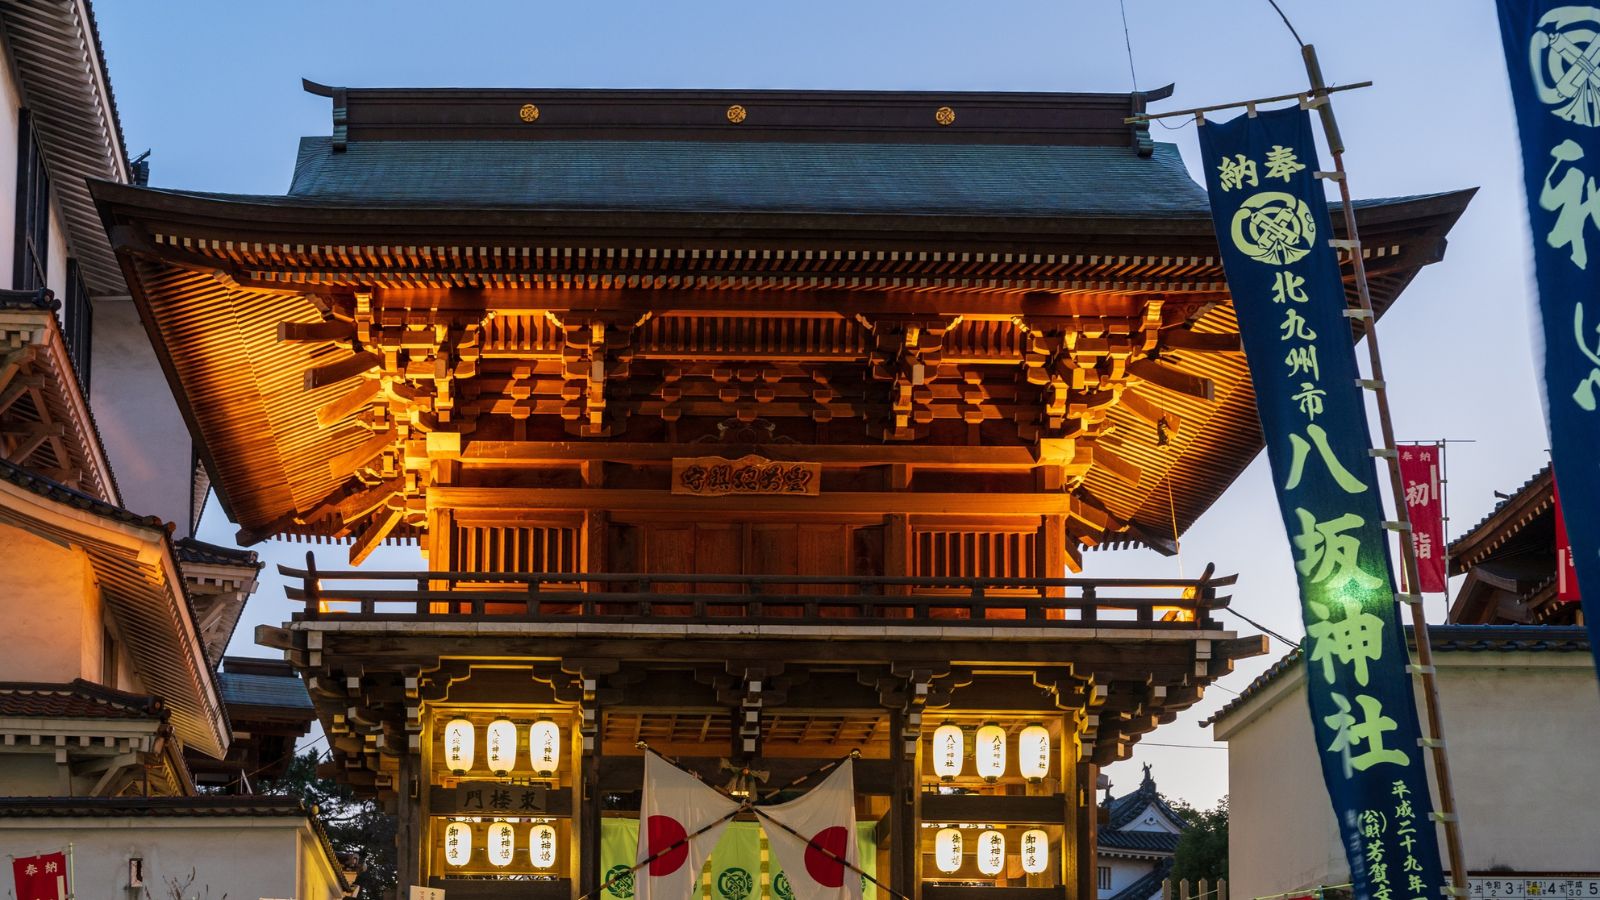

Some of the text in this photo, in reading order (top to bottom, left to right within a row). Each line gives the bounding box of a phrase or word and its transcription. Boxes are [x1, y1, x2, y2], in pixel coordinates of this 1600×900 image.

[1391, 779, 1428, 900] 平成二十九年
[1505, 882, 1514, 895] 3
[1547, 882, 1556, 895] 4
[1589, 882, 1599, 895] 5
